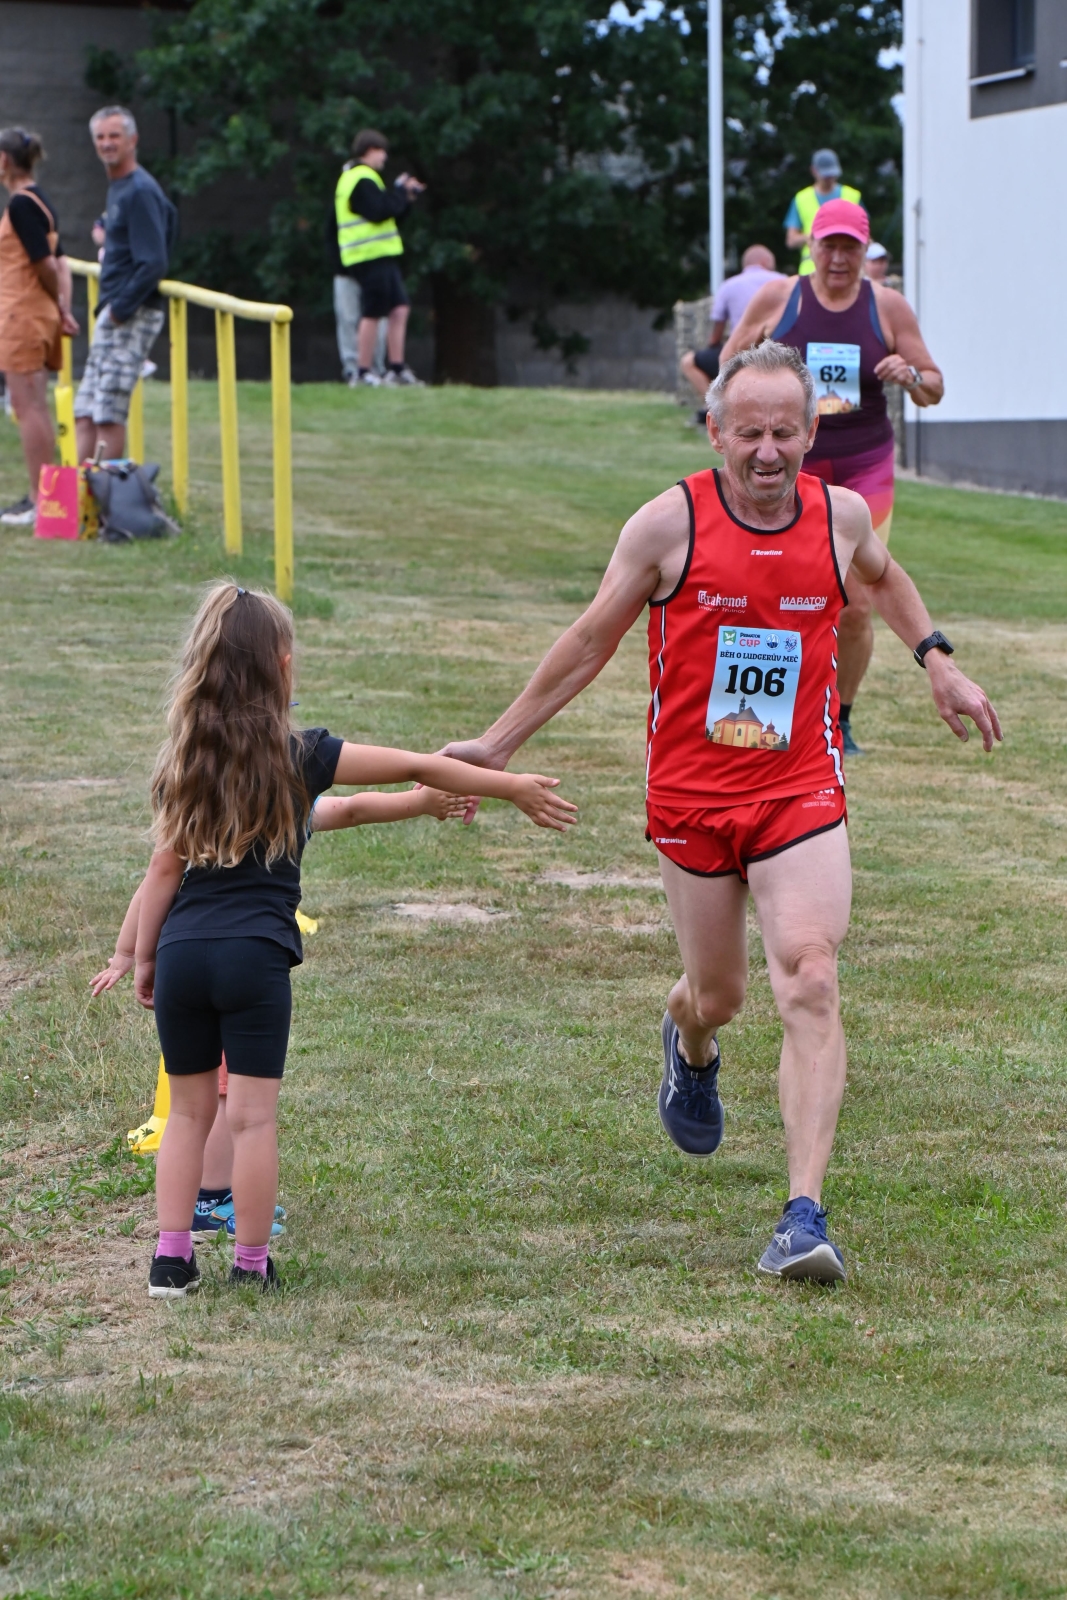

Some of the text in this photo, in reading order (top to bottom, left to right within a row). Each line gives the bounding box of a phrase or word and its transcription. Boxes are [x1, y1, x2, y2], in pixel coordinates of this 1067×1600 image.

[820, 365, 847, 383] 62
[780, 596, 828, 605] MARATON
[739, 638, 761, 647] CUP
[720, 650, 735, 659] BĚH
[743, 652, 782, 662] LUDGERŮV
[782, 654, 799, 663] MEČ
[724, 664, 788, 697] 106
